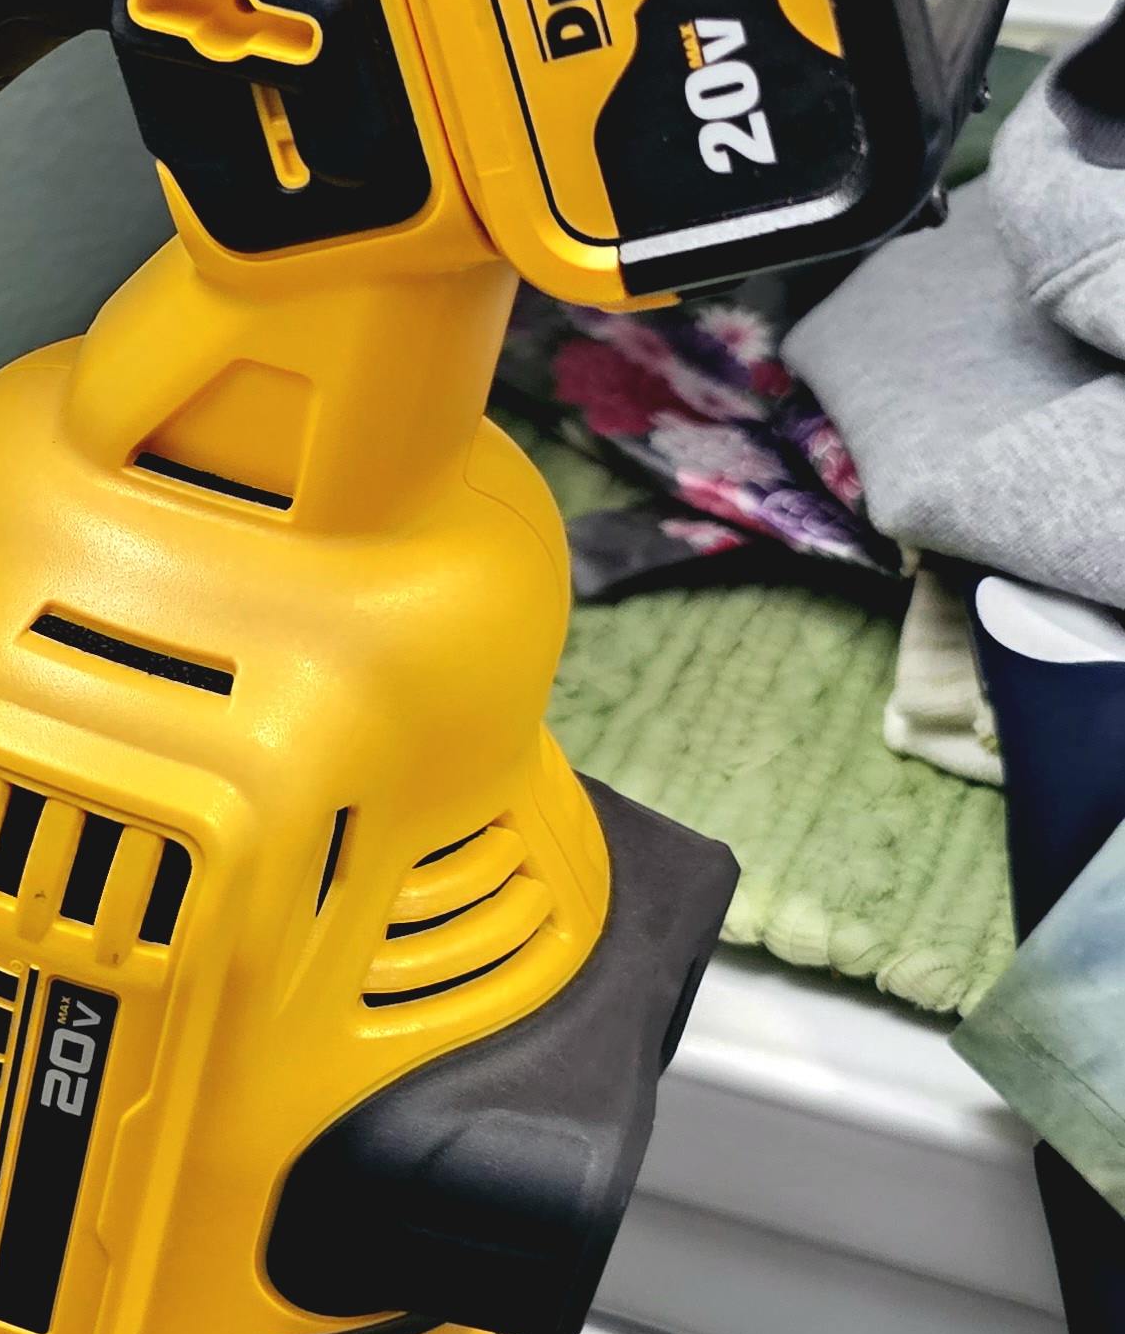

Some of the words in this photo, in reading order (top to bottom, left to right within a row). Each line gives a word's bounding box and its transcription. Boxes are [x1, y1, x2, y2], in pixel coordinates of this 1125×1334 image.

[678, 21, 704, 70] MAX
[684, 17, 777, 174] 20V
[56, 995, 72, 1025] MAX
[40, 1000, 102, 1117] 20V
